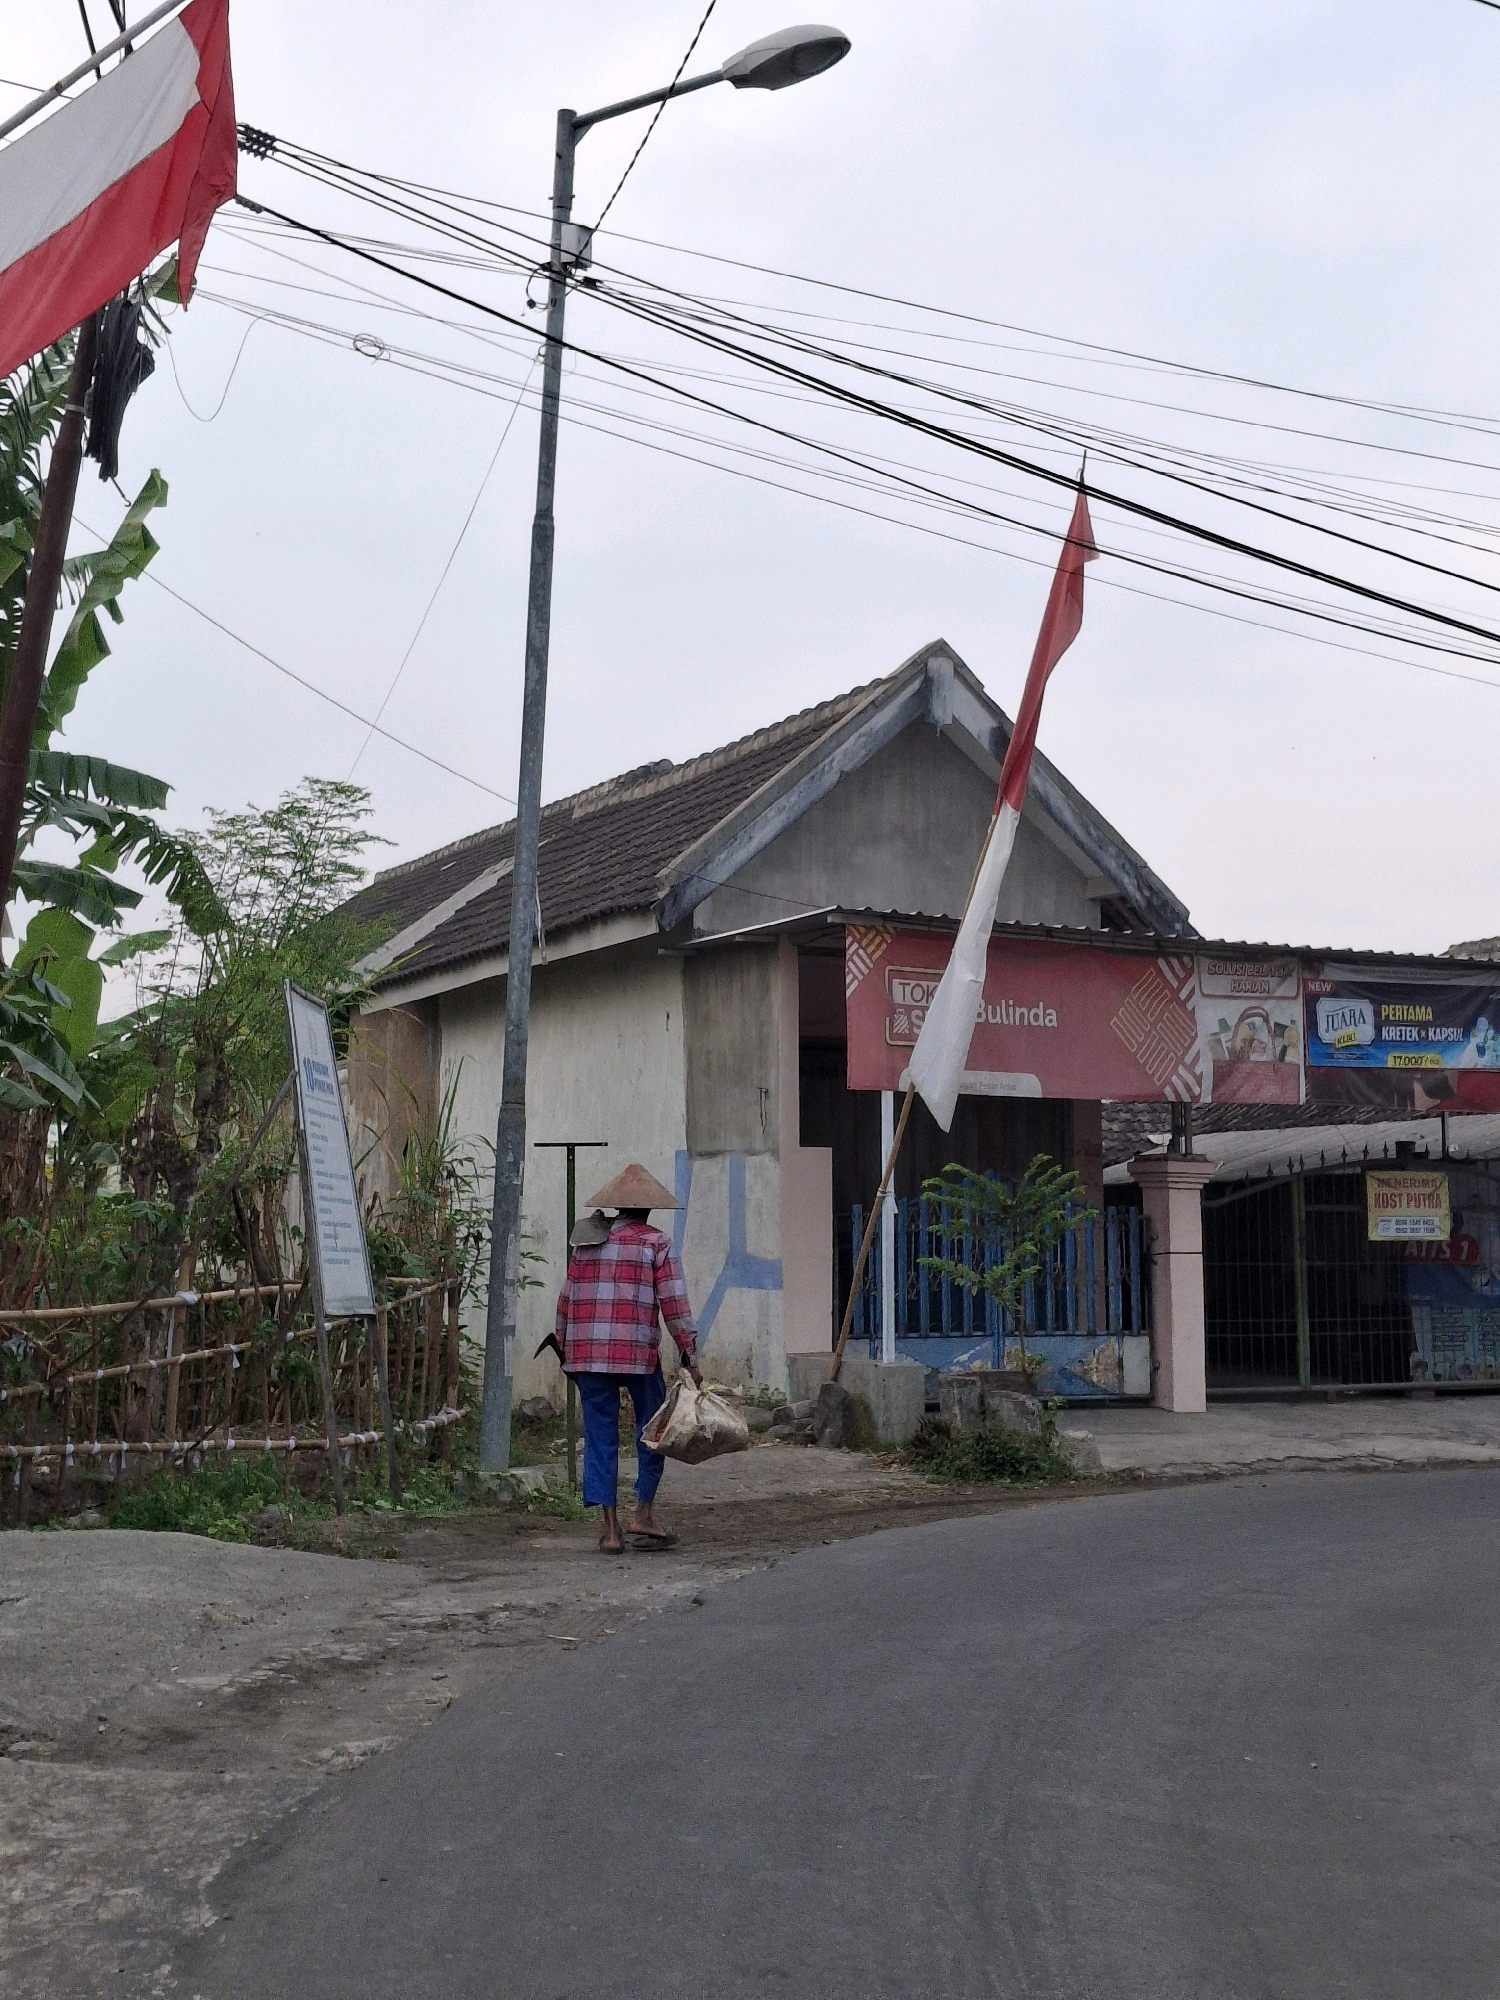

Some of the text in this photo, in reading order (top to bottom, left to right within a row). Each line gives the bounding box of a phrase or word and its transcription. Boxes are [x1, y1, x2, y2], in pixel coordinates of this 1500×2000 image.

[1207, 962, 1246, 976] SOLUSI
[898, 982, 939, 1004] TOK
[1231, 980, 1270, 994] HARIAN
[1308, 981, 1333, 992] NEW
[1325, 1007, 1367, 1034] JUARA
[1381, 1004, 1433, 1021] PERTAMA
[1381, 1026, 1419, 1041] KRETEK
[1428, 1027, 1464, 1042] KAPSUL
[1377, 1177, 1437, 1189] MENERIMA
[1406, 1192, 1442, 1209] PUTRA
[1404, 1240, 1469, 1260] ATIS 1
